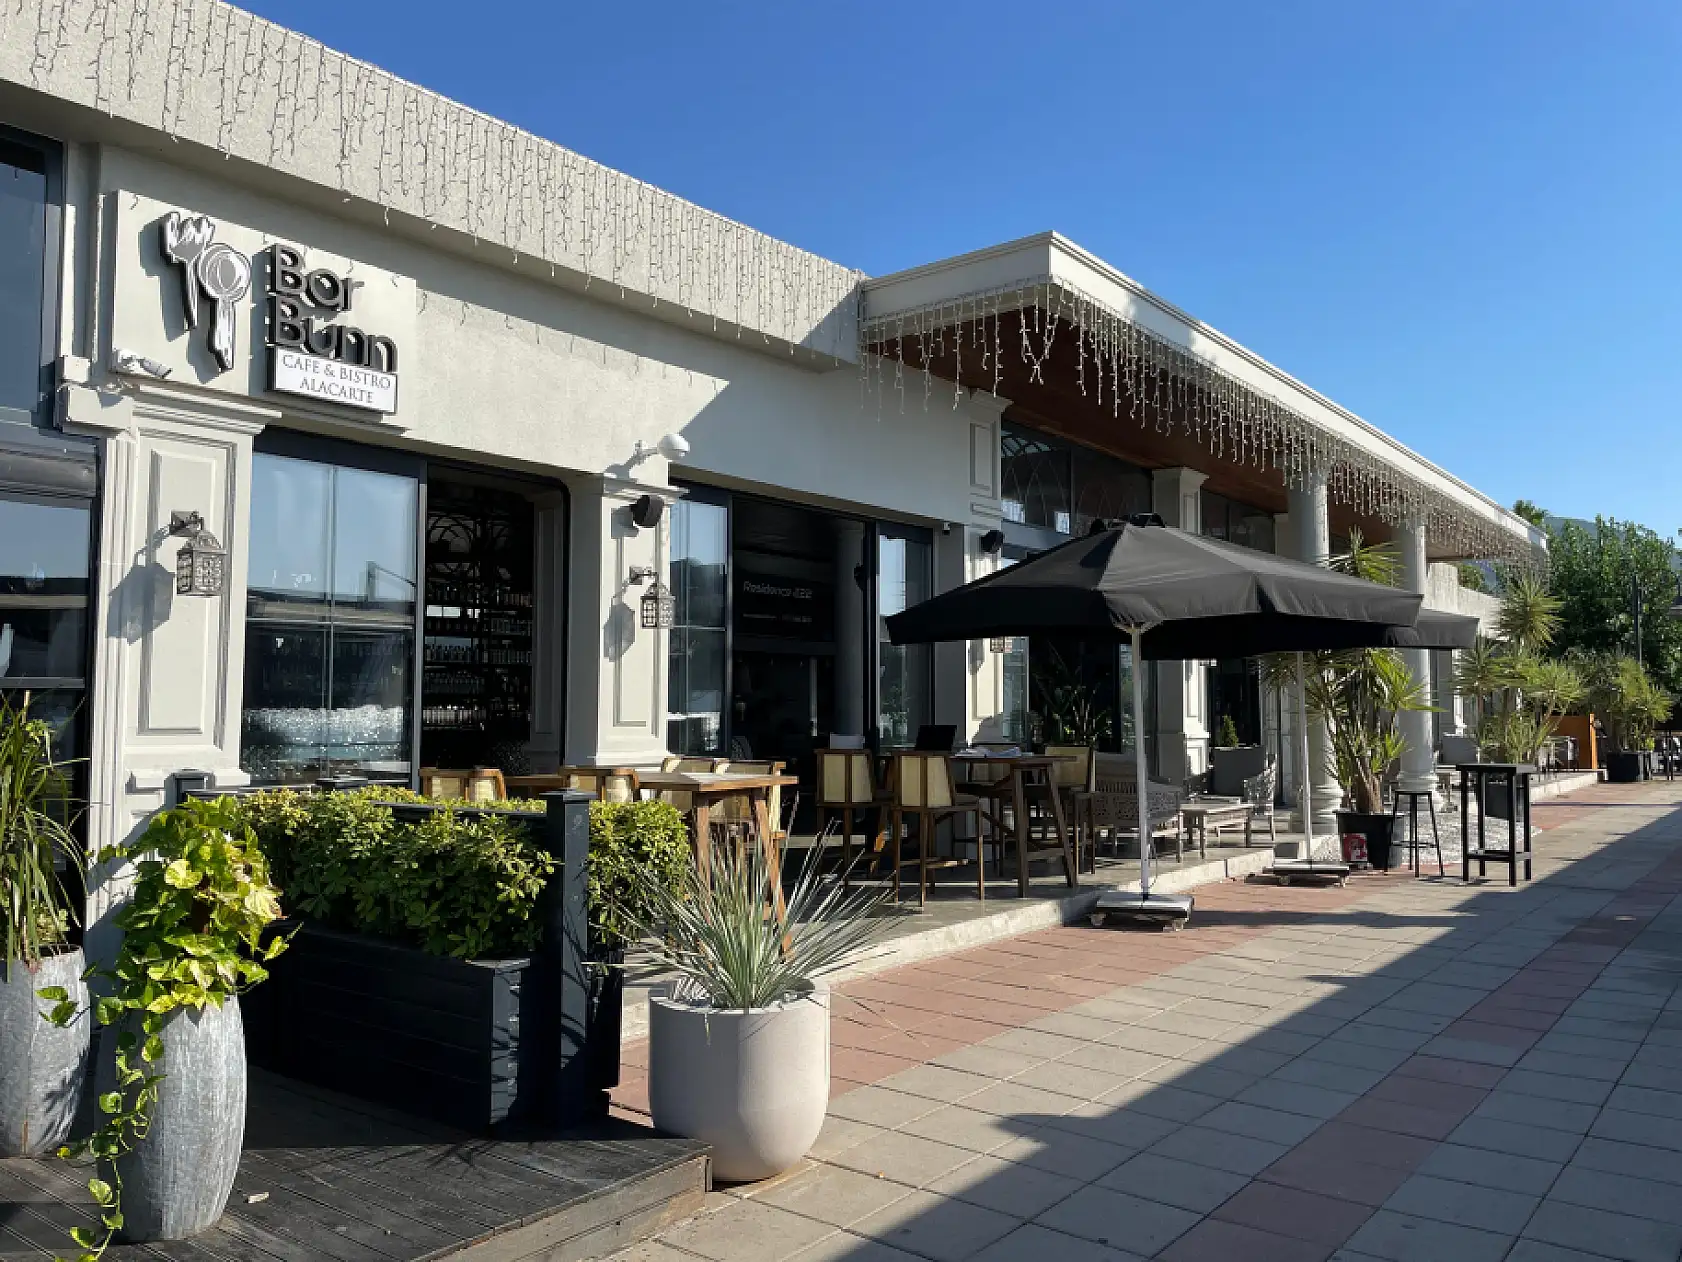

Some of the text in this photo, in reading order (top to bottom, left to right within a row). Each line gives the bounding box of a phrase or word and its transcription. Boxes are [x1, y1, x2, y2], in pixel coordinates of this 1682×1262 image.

[272, 243, 365, 312] Bar
[272, 296, 399, 374] Bunn
[282, 354, 391, 390] CAFE & BISTRO
[299, 377, 374, 404] ALACARTE
